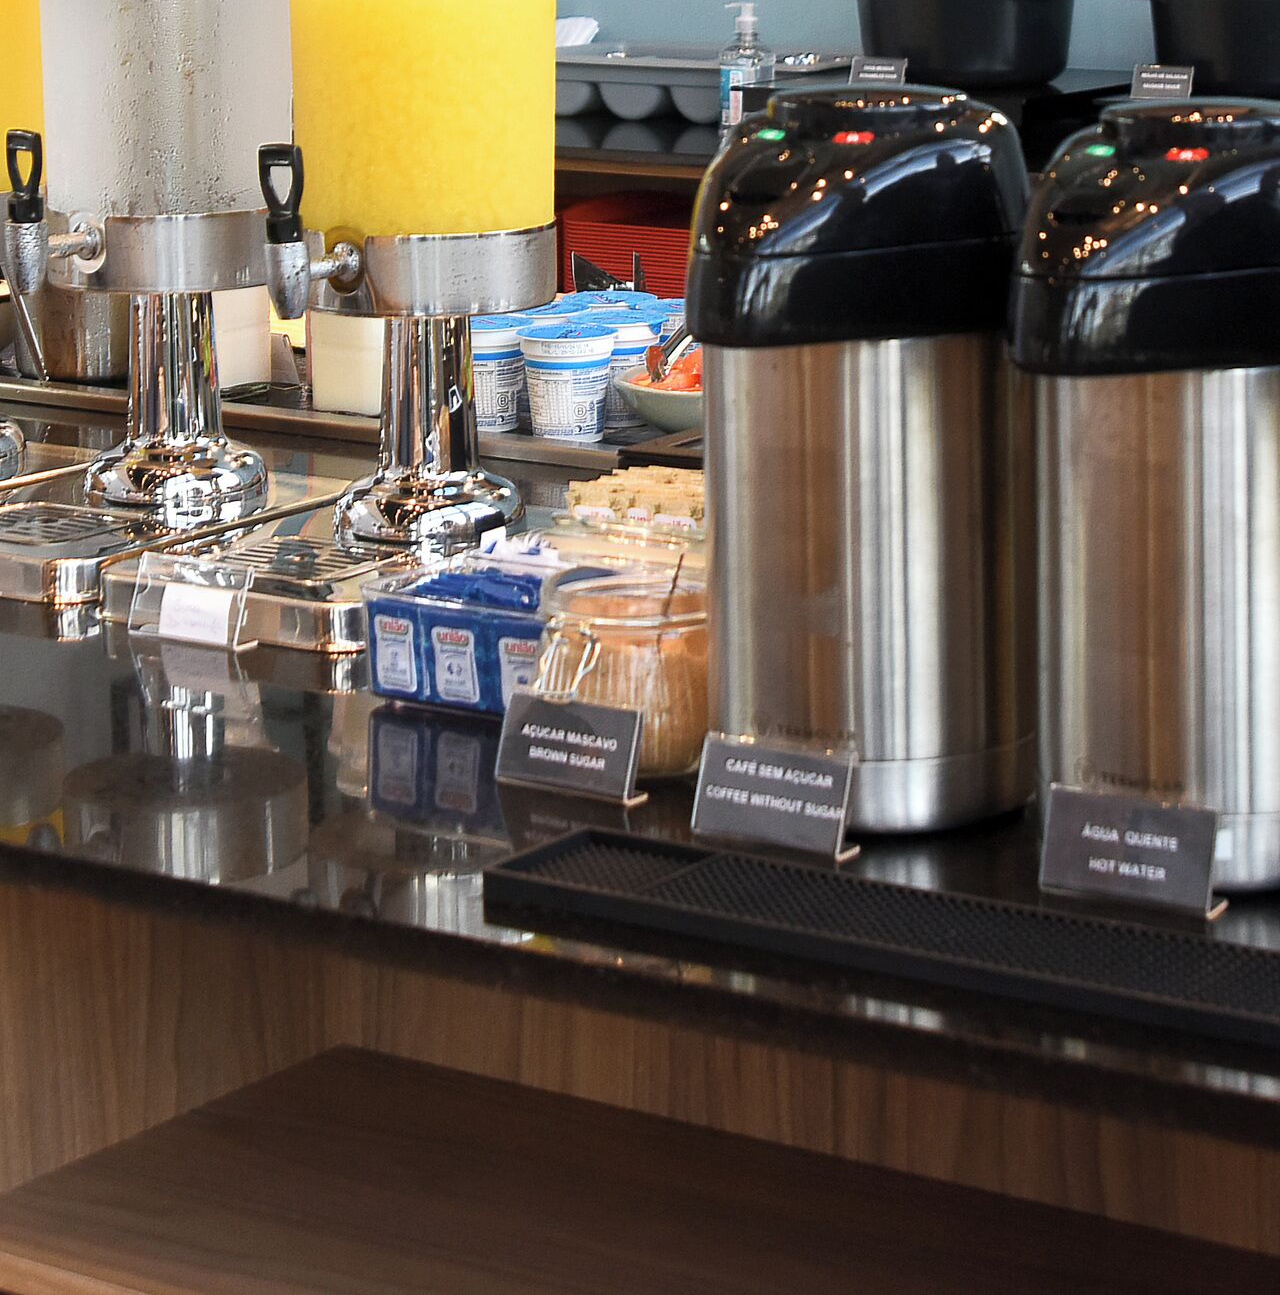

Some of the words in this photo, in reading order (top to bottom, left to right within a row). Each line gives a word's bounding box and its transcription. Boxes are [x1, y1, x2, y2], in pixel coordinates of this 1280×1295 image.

[438, 629, 468, 643] união
[566, 730, 618, 752] MASCAVO
[528, 745, 568, 764] BROWN
[568, 752, 606, 771] SUGAR
[725, 757, 757, 776] CAFÉ
[758, 763, 784, 780] SEM
[705, 784, 749, 805] COFFEE
[750, 792, 804, 814] WITHOUT
[804, 801, 844, 820] SUGAR
[1124, 830, 1179, 852] QUENTE
[1088, 856, 1117, 874] HOT
[1118, 861, 1167, 882] WATER
